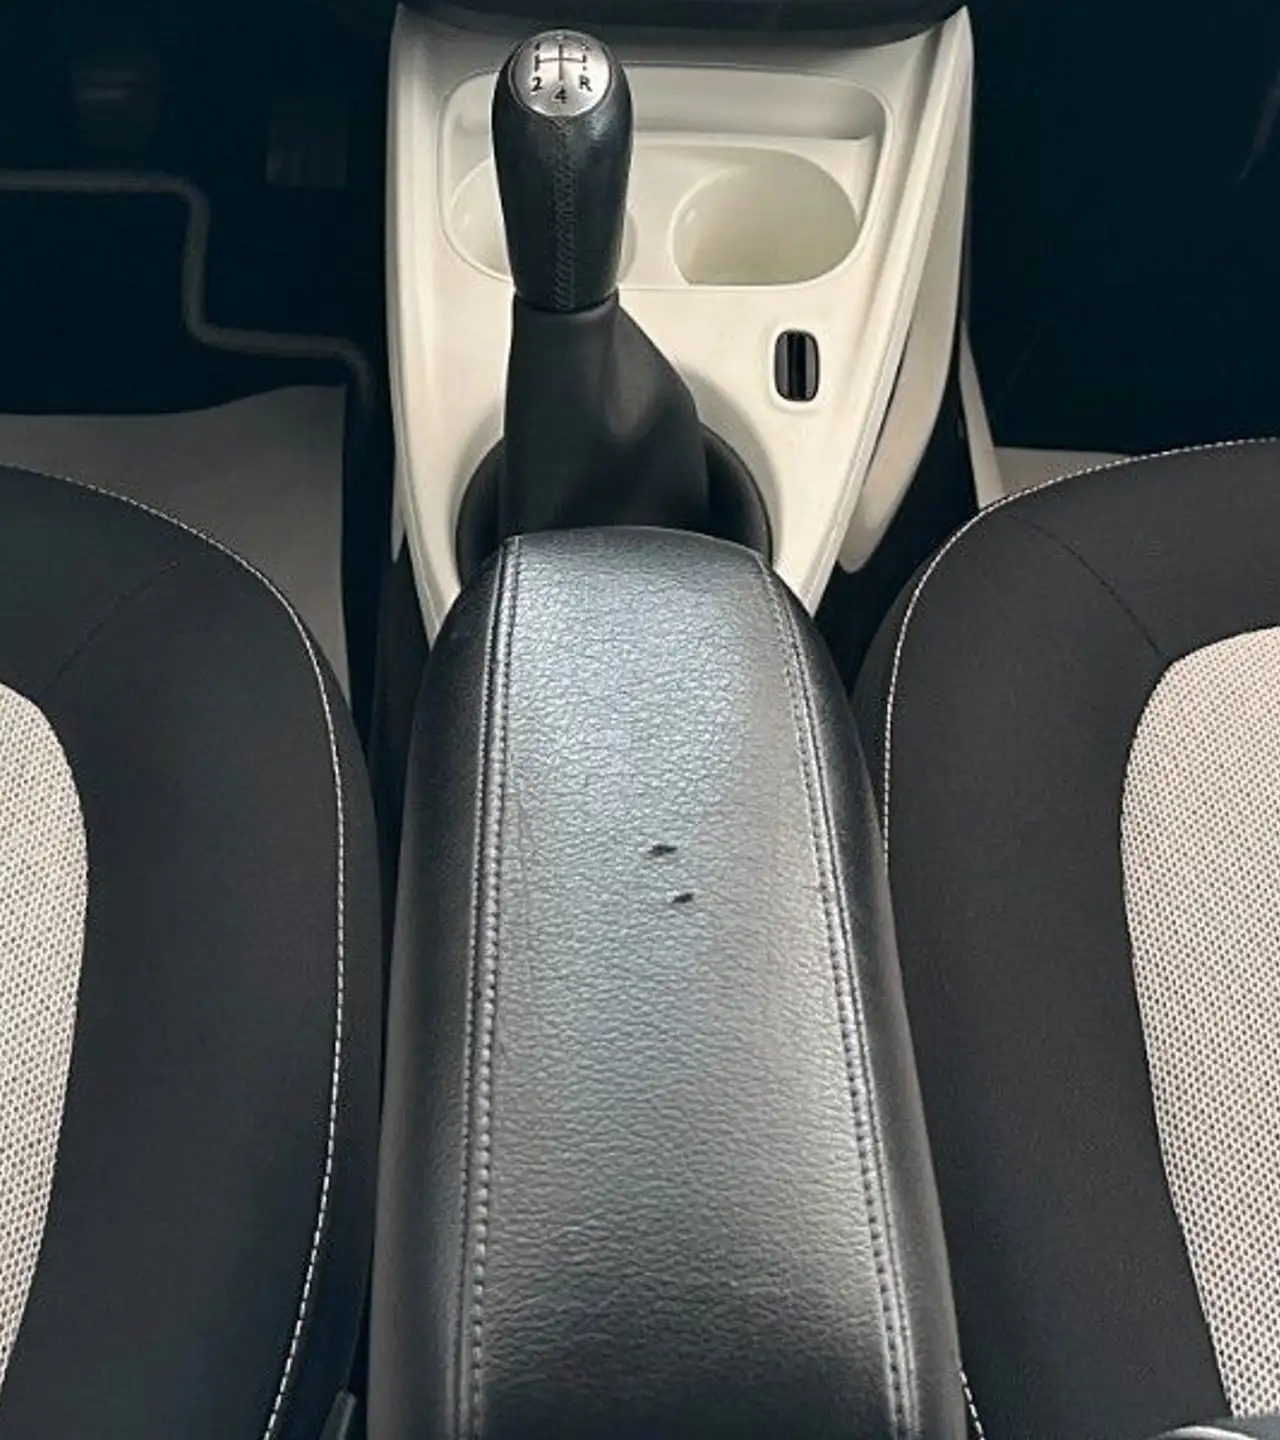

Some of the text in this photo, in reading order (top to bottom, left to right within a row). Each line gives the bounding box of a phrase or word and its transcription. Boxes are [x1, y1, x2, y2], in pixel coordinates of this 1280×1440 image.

[530, 76, 543, 93] 2
[578, 74, 593, 93] R
[554, 86, 567, 105] 4
